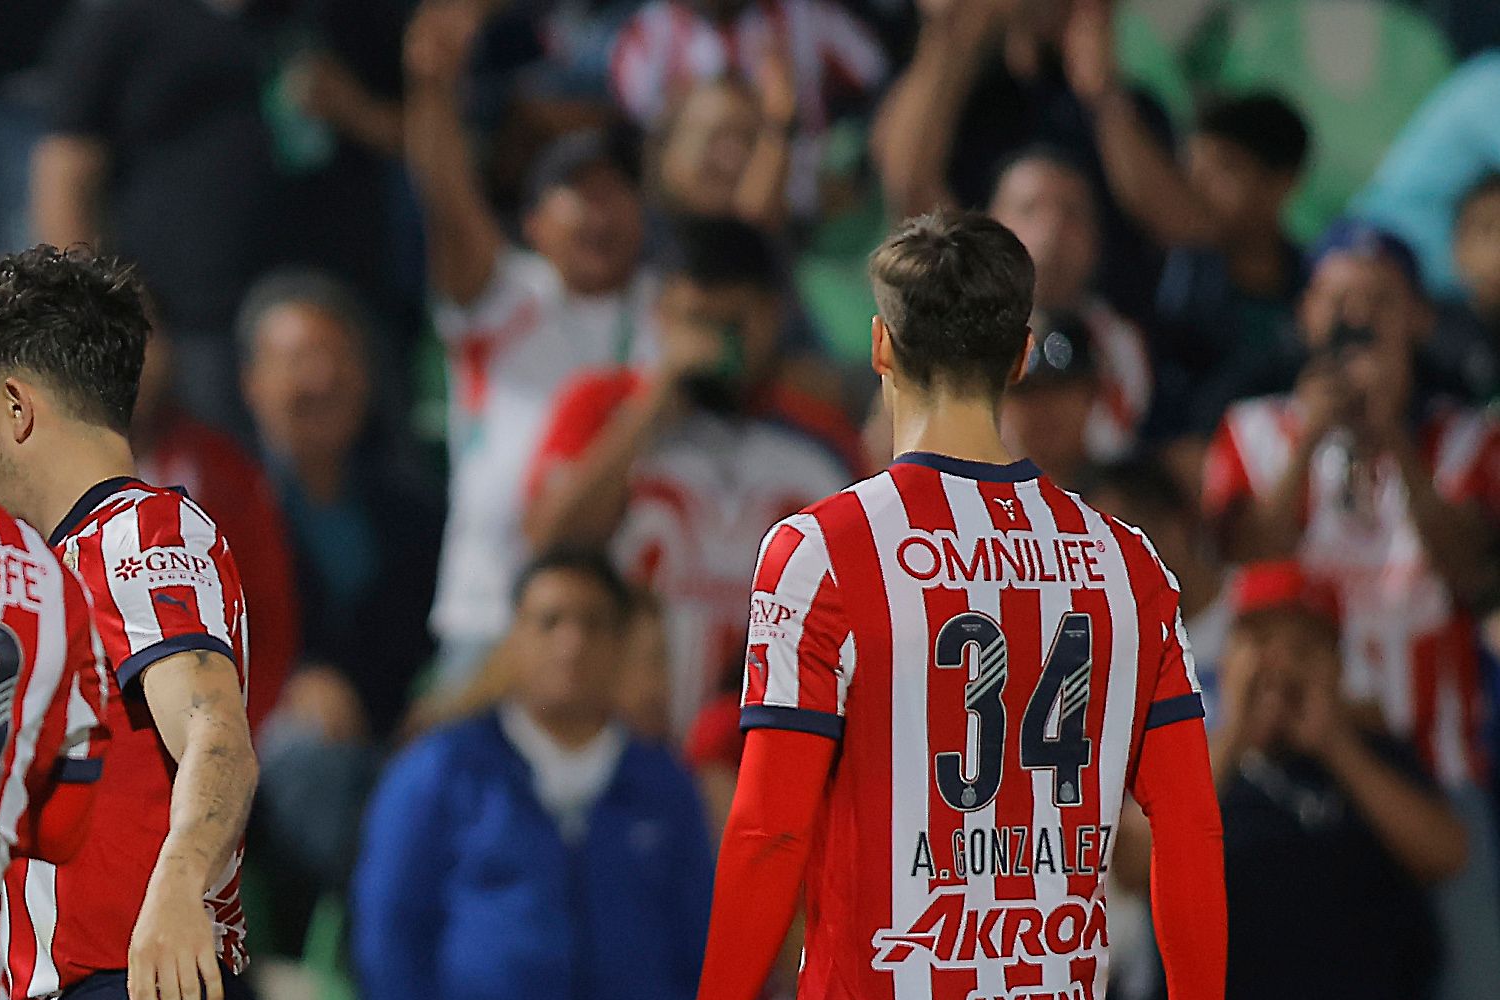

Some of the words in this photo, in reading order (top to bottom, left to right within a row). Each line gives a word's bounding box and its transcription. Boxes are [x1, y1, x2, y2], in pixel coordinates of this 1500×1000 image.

[145, 551, 207, 574] GNP
[896, 535, 1106, 582] OMNILIFE
[934, 612, 1092, 812] 34
[880, 893, 1110, 962] AKRON
